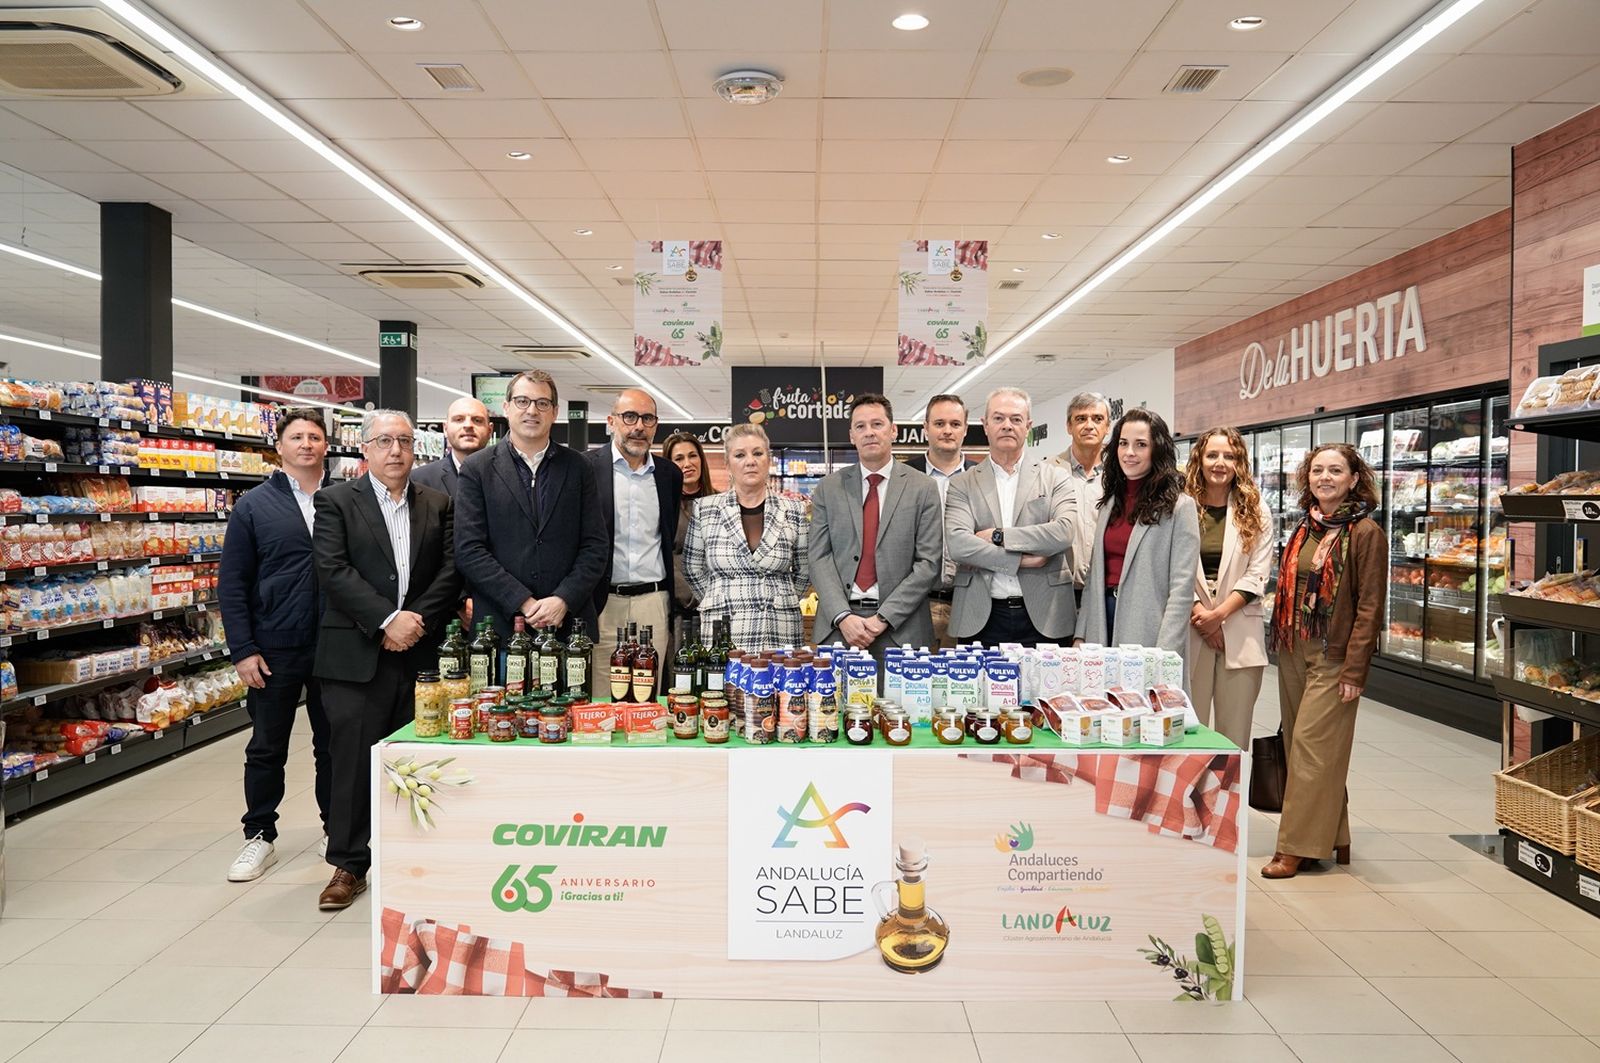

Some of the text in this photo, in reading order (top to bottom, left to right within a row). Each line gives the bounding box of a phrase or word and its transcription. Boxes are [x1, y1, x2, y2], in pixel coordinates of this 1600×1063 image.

[671, 328, 685, 339] 65
[935, 328, 949, 339] 65
[1290, 285, 1427, 384] HUERTA
[772, 386, 811, 410] fruta
[903, 666, 930, 675] PULEVA
[949, 666, 976, 675] PULEVA
[989, 667, 1016, 676] PULEVA
[753, 682, 774, 690] PULEV
[785, 682, 807, 690] PULEV
[816, 682, 836, 690] PULEV
[991, 683, 1015, 692] ORIGINAL
[580, 711, 607, 720] TEJERO
[632, 711, 658, 719] TEJERO
[492, 813, 668, 848] COVIRAN
[1009, 853, 1079, 867] Andaluces
[755, 864, 864, 881] ANDALUCÍA
[1007, 868, 1103, 884] Compartiendo
[560, 878, 656, 888] ANIVERSARIO
[491, 864, 558, 913] 65
[560, 891, 624, 901] ¡Gracias a ti!
[756, 885, 864, 915] SABE
[1001, 906, 1112, 934] LANDALUZ
[775, 929, 843, 939] LANDALUZ
